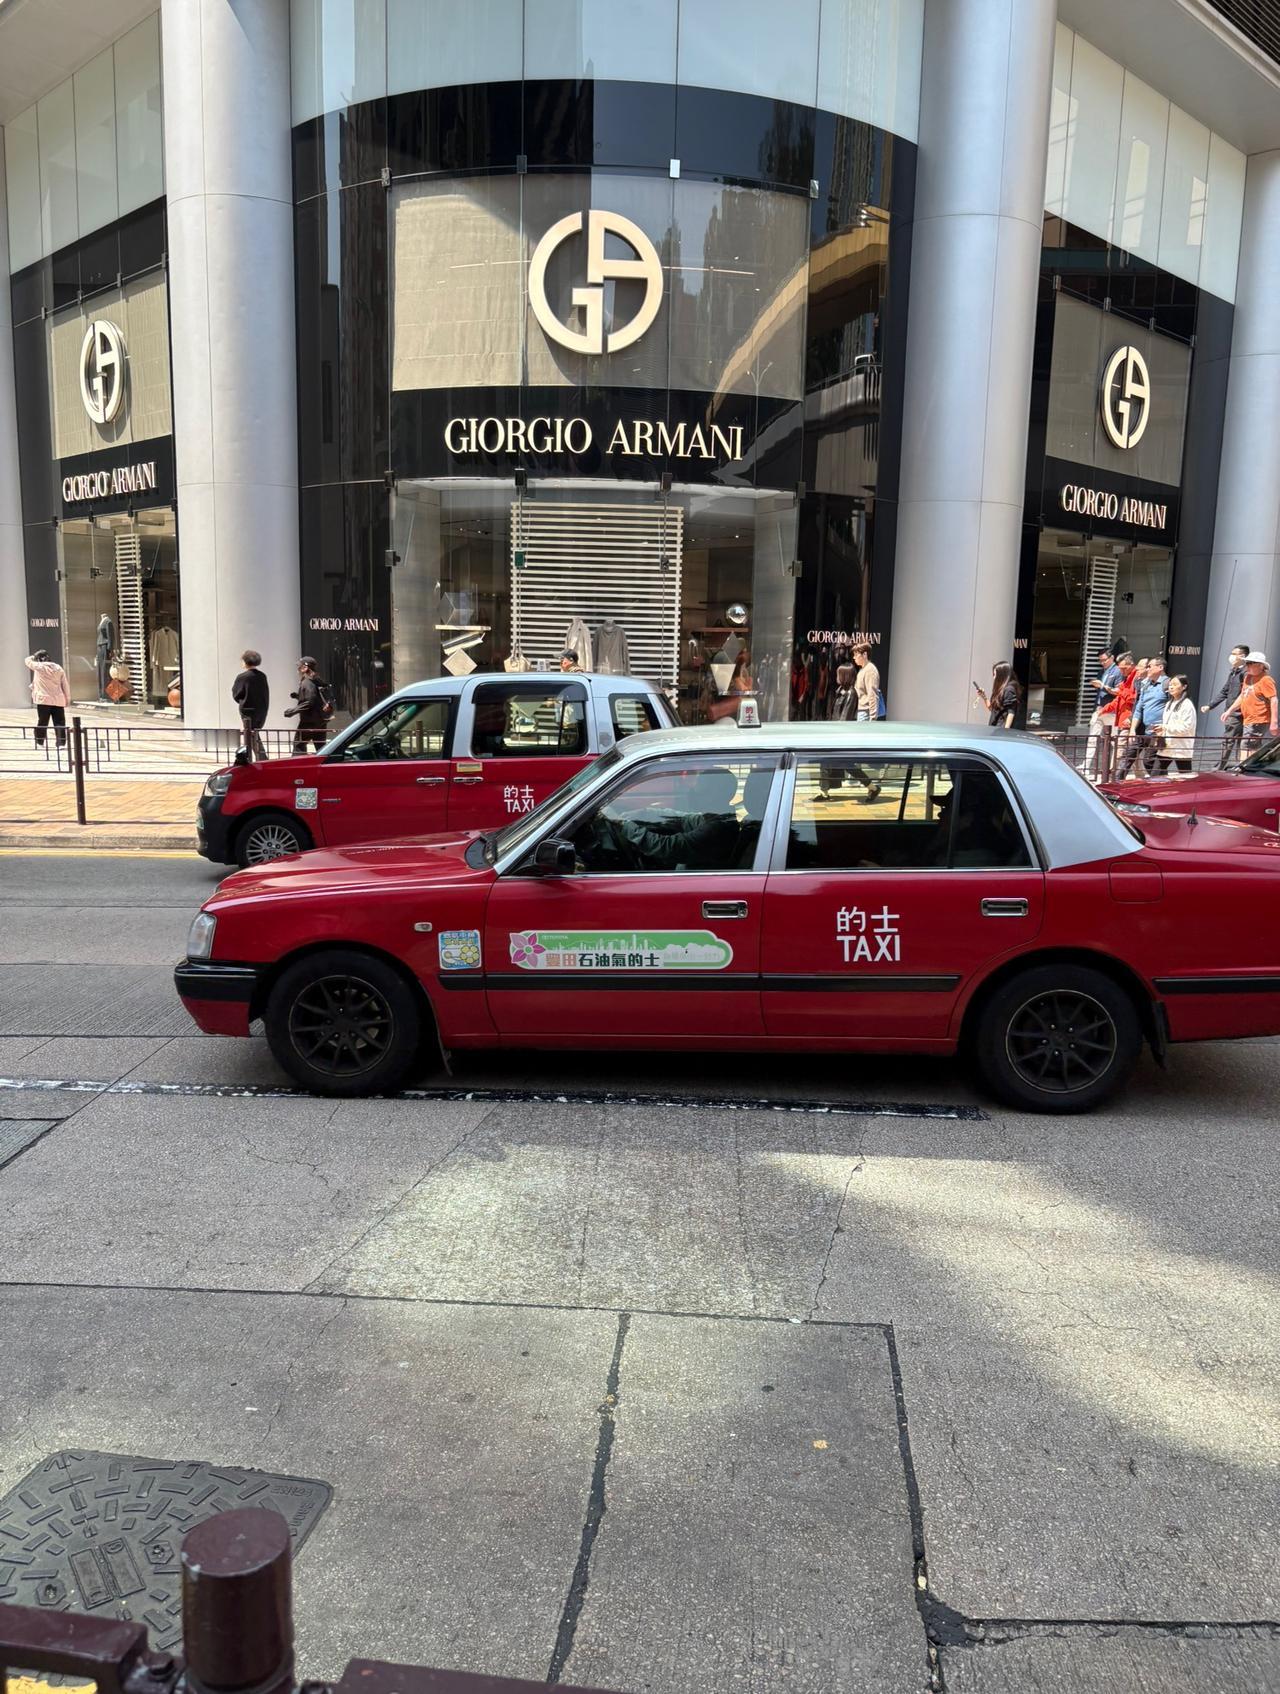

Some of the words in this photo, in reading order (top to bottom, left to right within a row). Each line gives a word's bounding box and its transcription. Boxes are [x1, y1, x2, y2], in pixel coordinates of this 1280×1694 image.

[444, 417, 593, 454] GIORGIO
[606, 419, 744, 461] ARMANI
[62, 471, 109, 503] GIORGIO
[110, 461, 156, 495] ARMANI
[1062, 484, 1118, 520] GIORGIO
[1120, 497, 1168, 530] ARMANI
[309, 618, 342, 630] GIORGIO
[344, 618, 379, 631] ARMANI
[807, 630, 847, 643] GIORGIO
[849, 631, 881, 645] ARMANI
[504, 785, 534, 799] 的士
[504, 799, 534, 813] TAXI
[836, 905, 900, 933] 的士
[836, 935, 901, 962] TAXI
